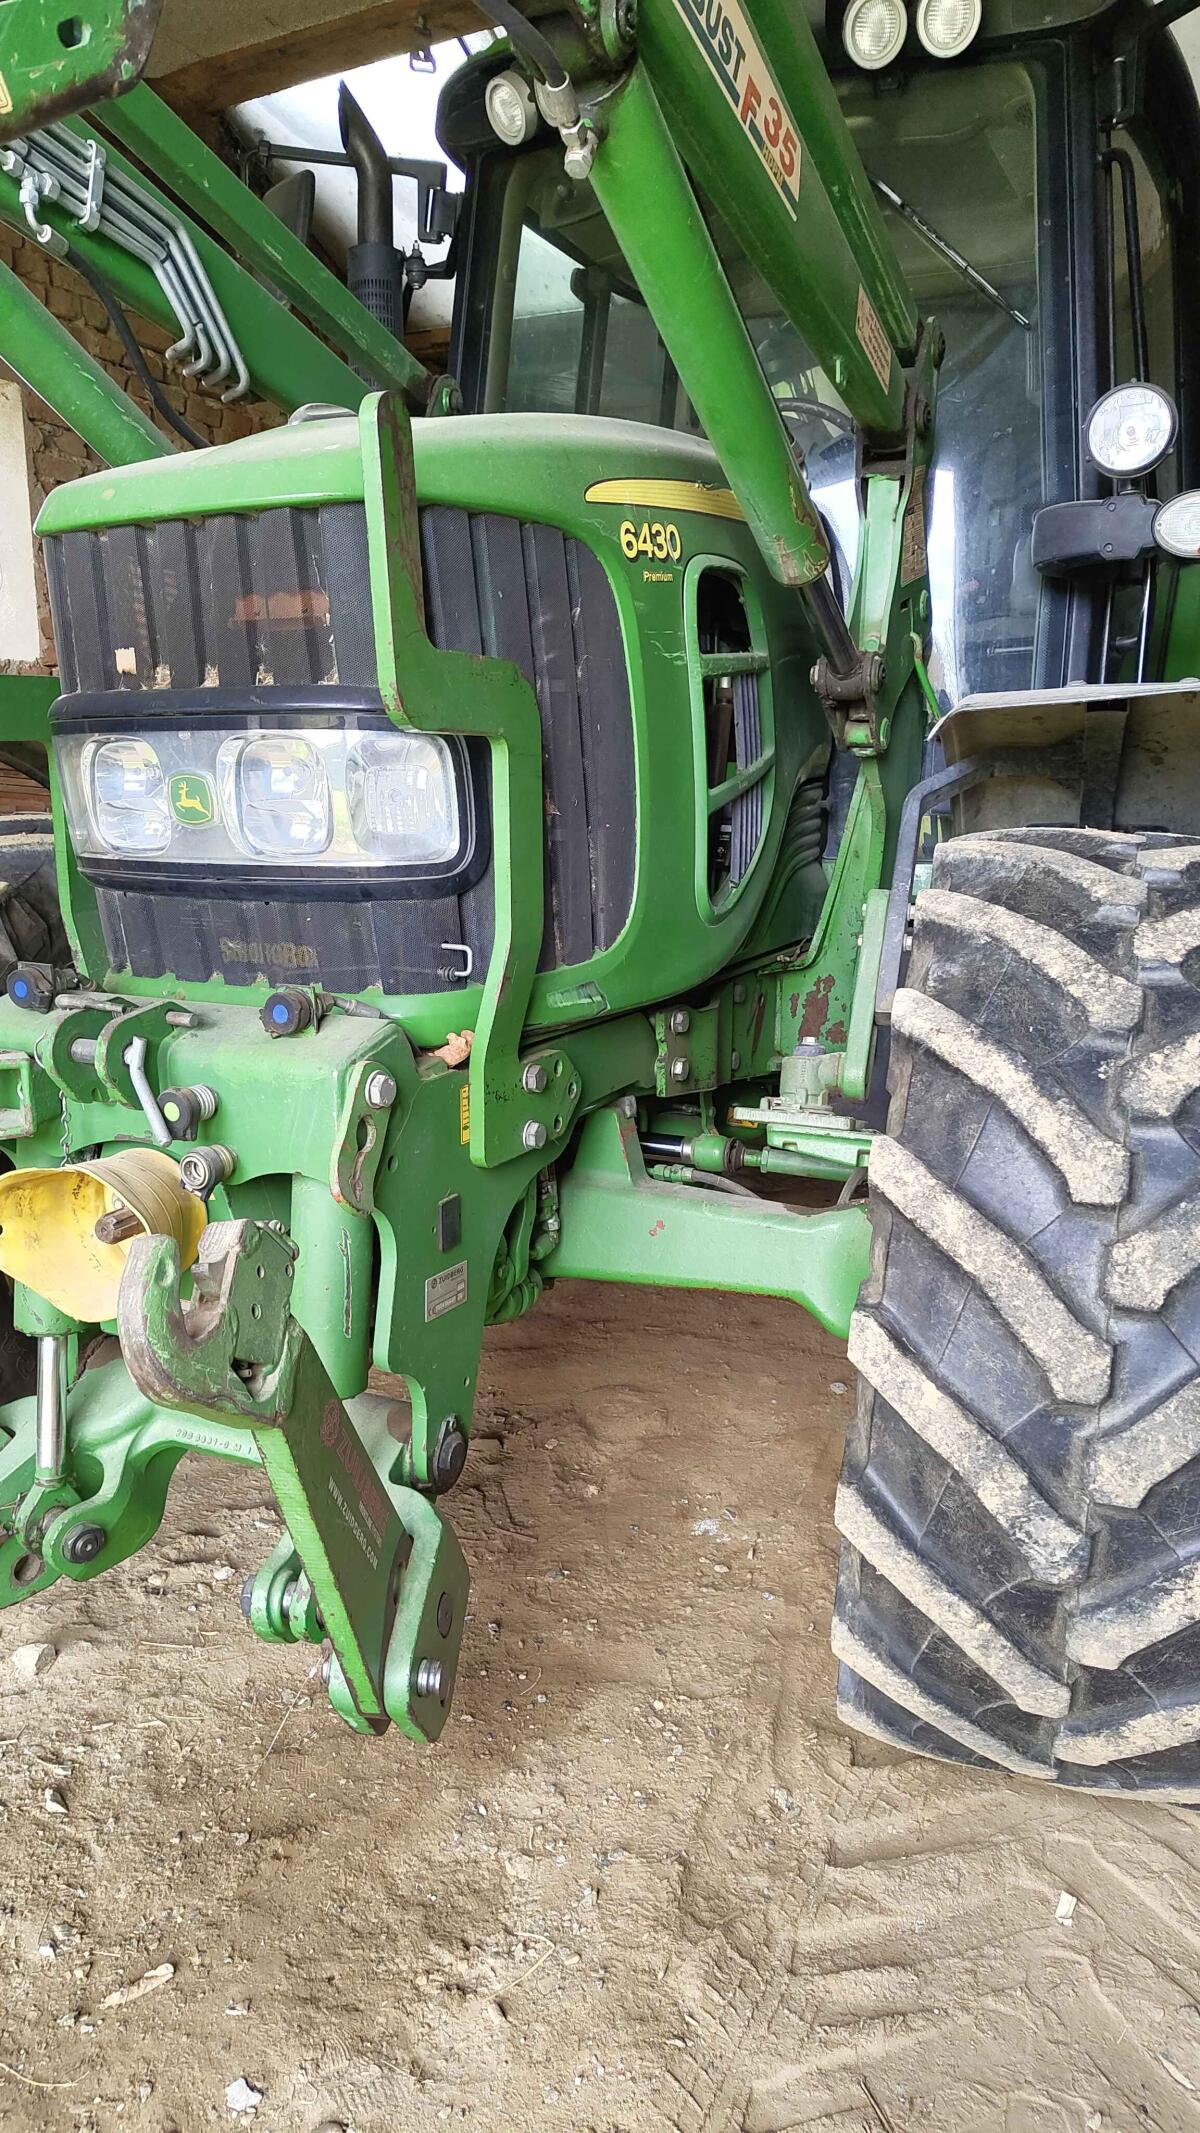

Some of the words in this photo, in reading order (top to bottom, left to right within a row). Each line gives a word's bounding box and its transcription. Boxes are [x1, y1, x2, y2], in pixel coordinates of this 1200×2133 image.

[694, 0, 746, 82] UST
[740, 74, 762, 125] F
[763, 96, 797, 177] 35
[620, 520, 682, 561] 6430
[643, 570, 673, 582] Premium
[438, 1265, 464, 1284] ZUIDBERG
